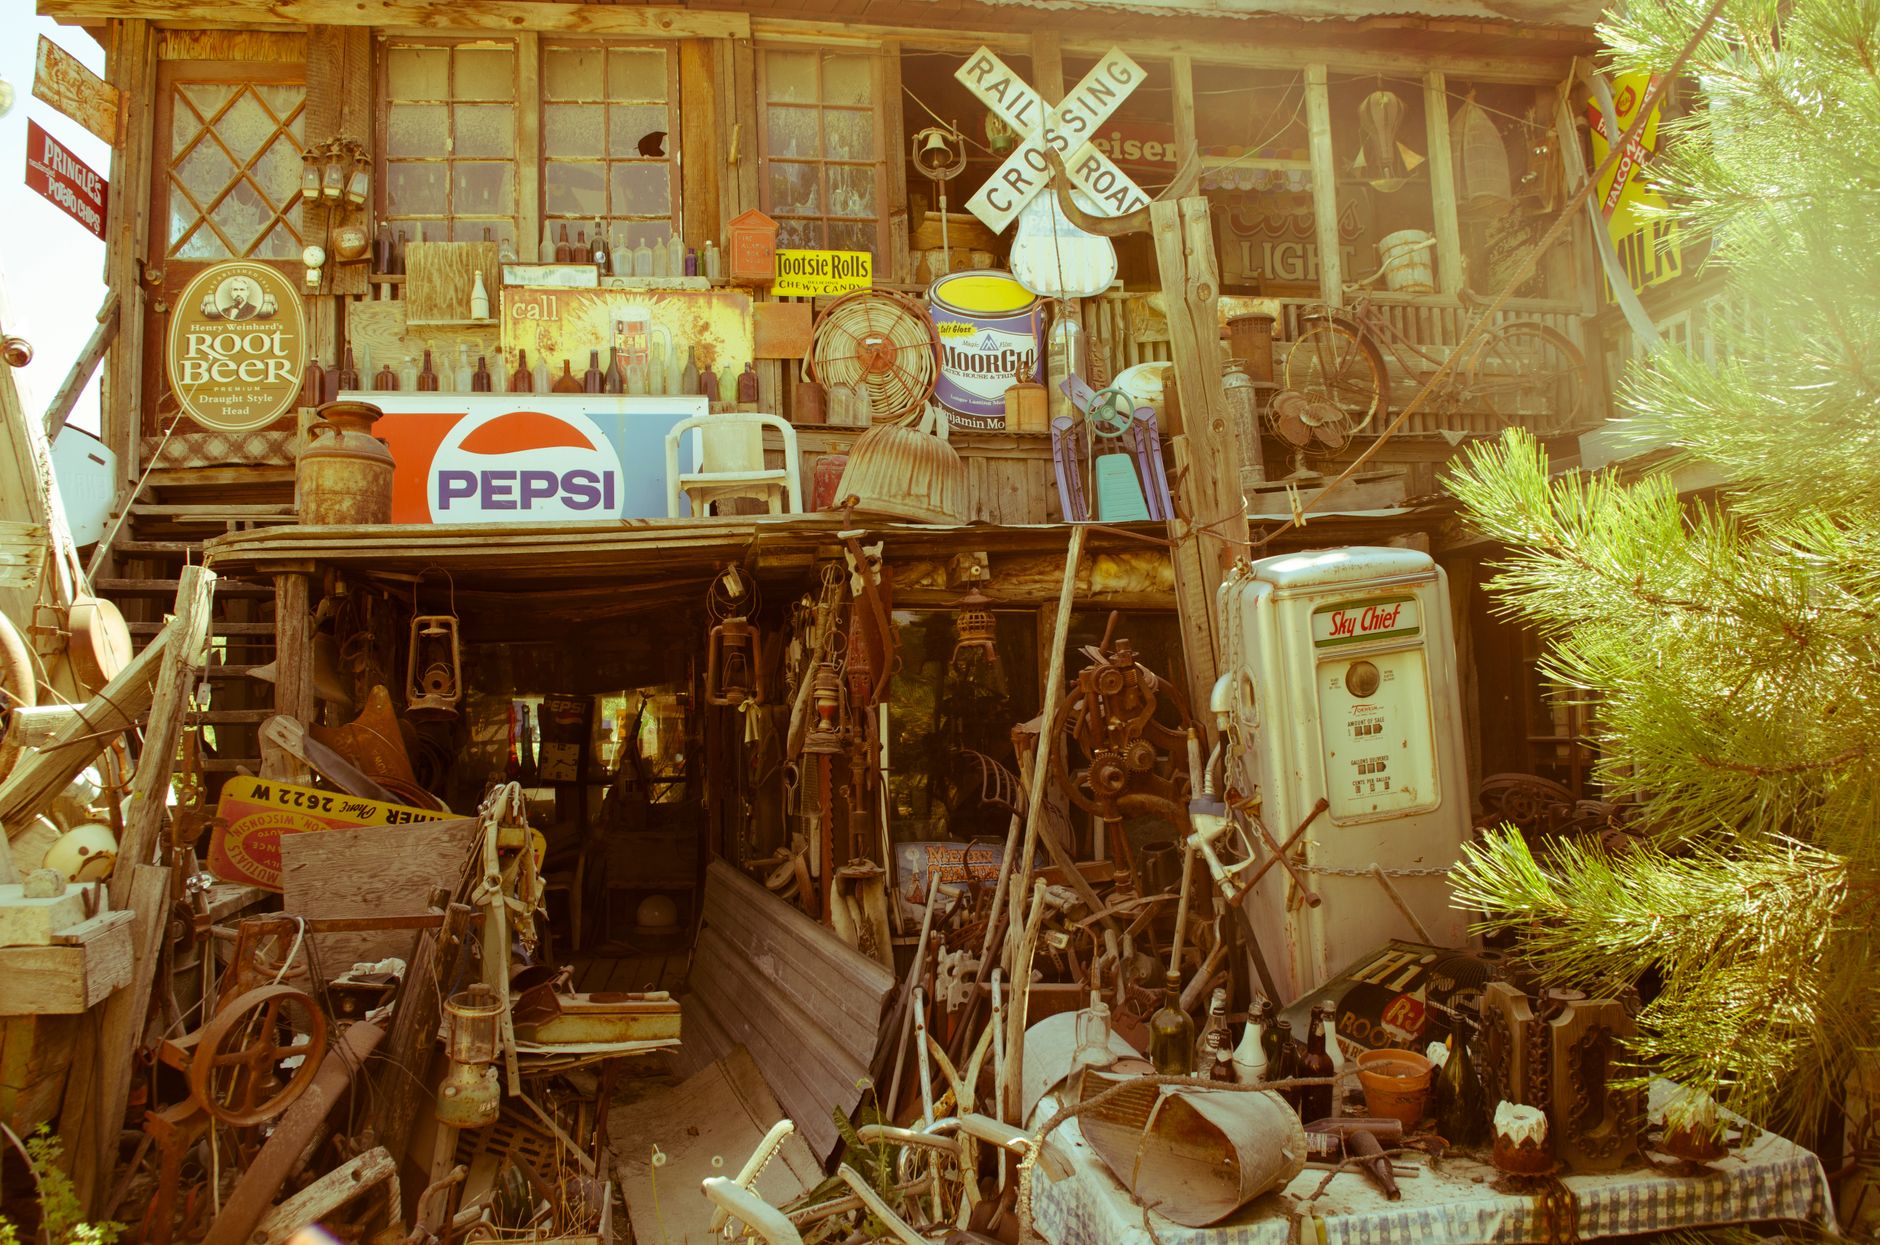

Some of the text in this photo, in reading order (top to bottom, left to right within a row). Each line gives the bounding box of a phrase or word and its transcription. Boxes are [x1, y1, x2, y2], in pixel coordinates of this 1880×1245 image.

[966, 55, 1034, 128] RAIL
[986, 61, 1132, 213] CROSSING
[1092, 131, 1177, 162] eiser
[775, 253, 869, 279] Tootsie Rolls
[511, 295, 559, 321] call
[191, 322, 284, 333] Henry Weinhard's
[952, 325, 972, 333] Gloss
[962, 371, 989, 380] HOUSE
[199, 393, 273, 404] Draught Style
[222, 406, 250, 415] Head
[438, 469, 616, 511] PEPSI
[1328, 603, 1402, 637] Sky Chief
[1347, 718, 1367, 727] AMOUNT
[1374, 715, 1385, 724] SALE
[250, 783, 271, 801] W
[279, 786, 334, 813] 2622
[227, 844, 279, 884] MUTUALS
